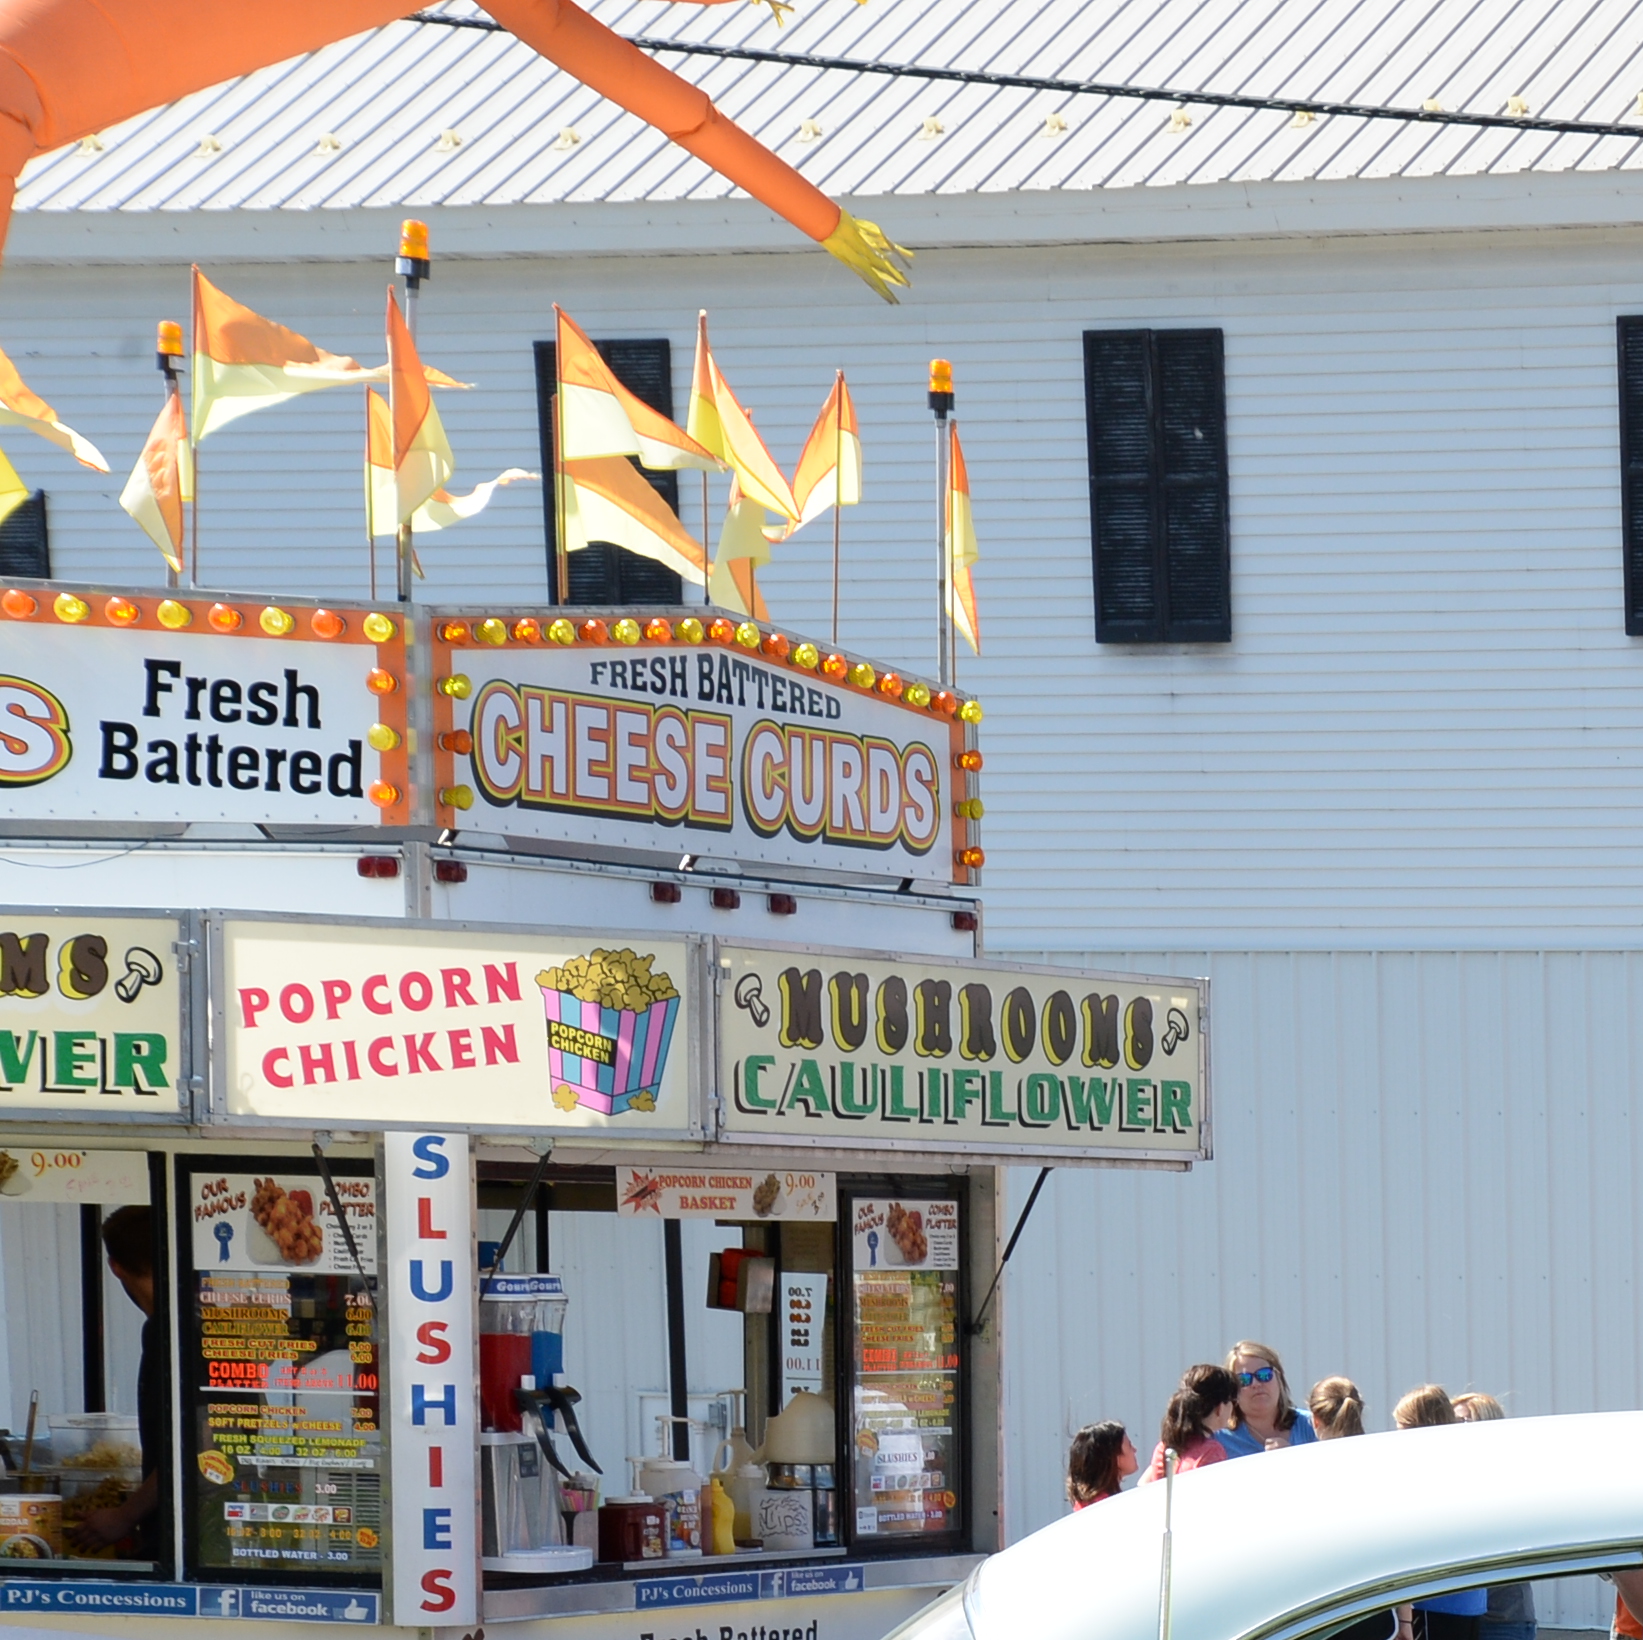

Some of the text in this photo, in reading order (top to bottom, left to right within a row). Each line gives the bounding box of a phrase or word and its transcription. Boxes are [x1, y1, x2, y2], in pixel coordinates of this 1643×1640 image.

[143, 657, 322, 729] Fresh
[590, 652, 841, 720] FRESH BATTERED
[98, 720, 364, 799] Battered
[470, 679, 940, 856] CHEESE CURDS
[239, 961, 524, 1029] POPCORN
[779, 966, 1155, 1071] MUSHROOMS
[550, 1021, 612, 1052] POPCORN
[261, 1023, 520, 1090] CHICKEN
[551, 1035, 610, 1064] CHICKEN
[735, 1054, 1193, 1135] CAULIFLOWER
[31, 1151, 81, 1177] 9.00
[201, 1178, 229, 1200] OUR
[658, 1174, 752, 1189] POPCORN CHICKEN
[785, 1172, 815, 1196] 9.00
[195, 1191, 247, 1222] FAMOUS
[319, 1201, 376, 1218] PLTTER
[679, 1196, 736, 1210] BASKET
[200, 1292, 292, 1304] CHEESE CURDS
[201, 1308, 289, 1320] MUSHROOMS
[346, 1308, 372, 1321] 6.00
[202, 1321, 290, 1336] CAULIFLOWER
[345, 1323, 372, 1336] 6.00
[202, 1338, 317, 1351] FRESH CUT FRIES
[349, 1341, 372, 1352] 5.00
[202, 1349, 298, 1361] CHEESE FRIES
[350, 1353, 372, 1363] 6.00
[208, 1361, 269, 1378] COMBO
[409, 1134, 457, 1613] SLUSHIES
[337, 1373, 378, 1389] 11.00
[207, 1403, 307, 1416] POPCORN CHICKEN
[208, 1417, 342, 1432] SOFT PRETZELS CHEESE
[353, 1421, 376, 1432] 4.00
[213, 1433, 367, 1447] FRESH SQUEEZED LEMONADE
[236, 1446, 250, 1455] OZ
[296, 1447, 309, 1456] 32
[311, 1447, 326, 1457] OZ
[877, 1452, 918, 1464] SLUSHIES
[232, 1480, 337, 1494] SLUSHIES 3.00
[232, 1548, 349, 1561] BOTTLED WATER 3.00
[791, 1570, 824, 1579] like us on
[641, 1582, 753, 1601] PJ's Concessions
[791, 1578, 836, 1592] facebook
[6, 1589, 188, 1609] PJ's Concessions
[250, 1589, 306, 1602] like us on
[250, 1601, 328, 1616] facebook
